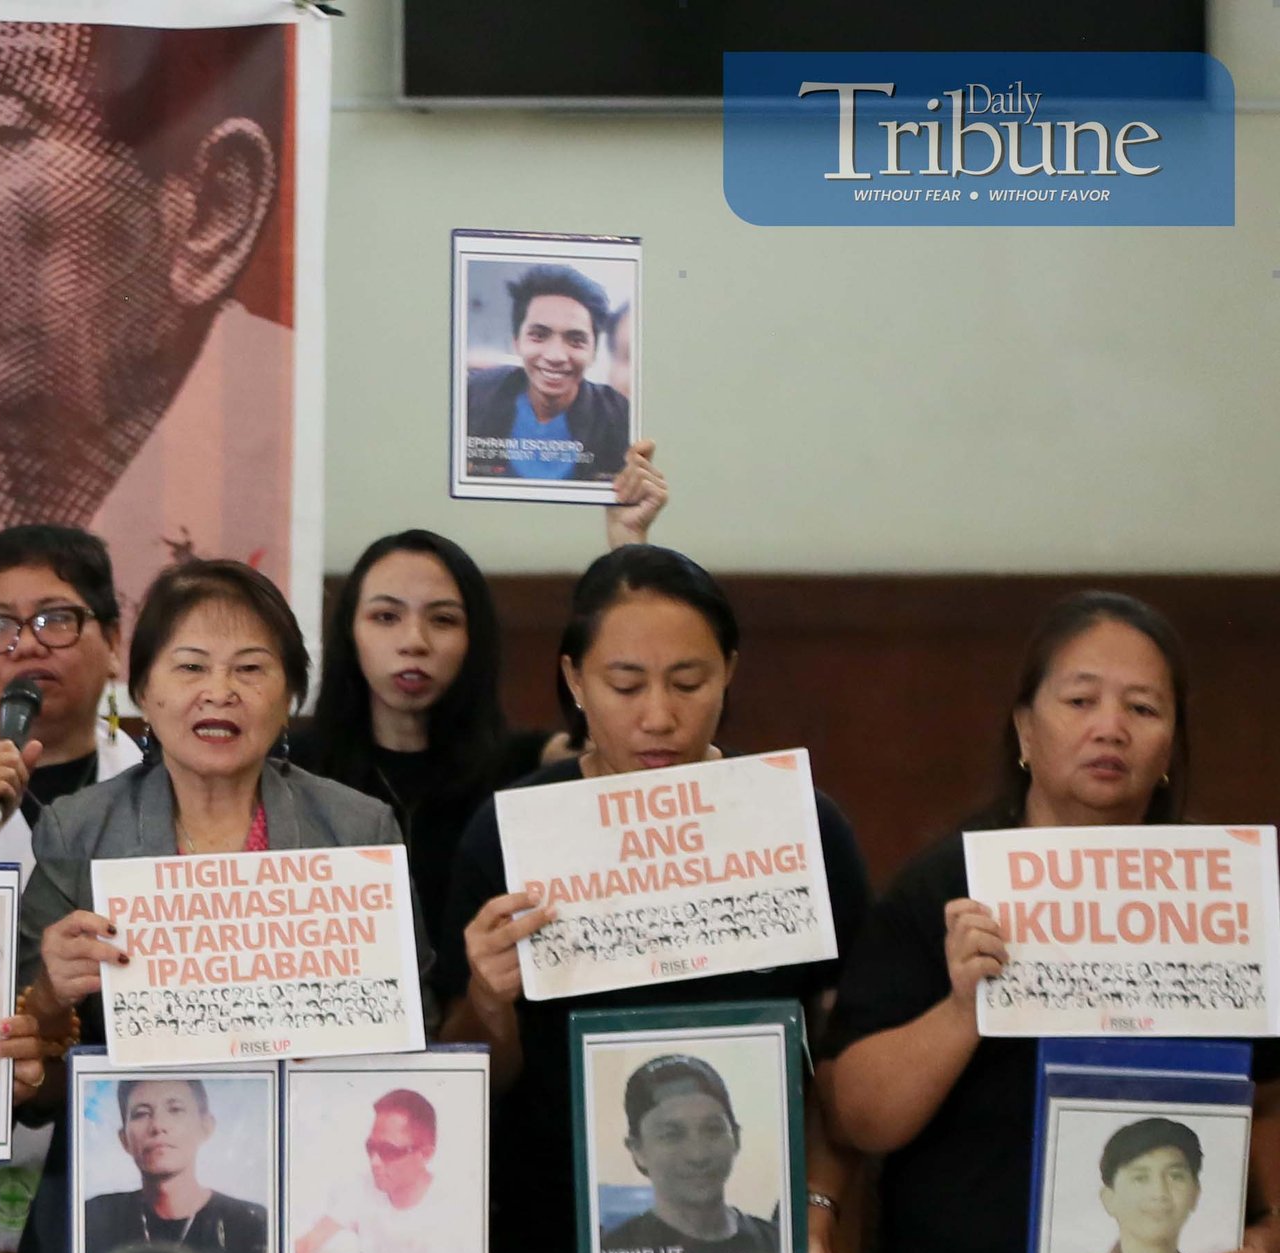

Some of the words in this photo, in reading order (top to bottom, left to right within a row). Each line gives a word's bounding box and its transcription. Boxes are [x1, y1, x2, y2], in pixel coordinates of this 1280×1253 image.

[598, 781, 715, 827] ITIGIL
[619, 821, 704, 862] ANG
[154, 859, 248, 890] ITIGIL
[256, 854, 333, 885] ANG
[524, 843, 807, 907] PAMAMASLANG!
[1008, 848, 1232, 891] DUTERTE
[108, 883, 393, 924] PAMAMASLANG!
[998, 901, 1250, 945] IKULONG!
[126, 916, 377, 957] KATARUNGAN
[147, 949, 361, 987] IPAGLABAN!
[660, 960, 689, 973] RISE
[691, 956, 708, 970] UP
[240, 1041, 271, 1054] RISE
[273, 1040, 291, 1051] UP
